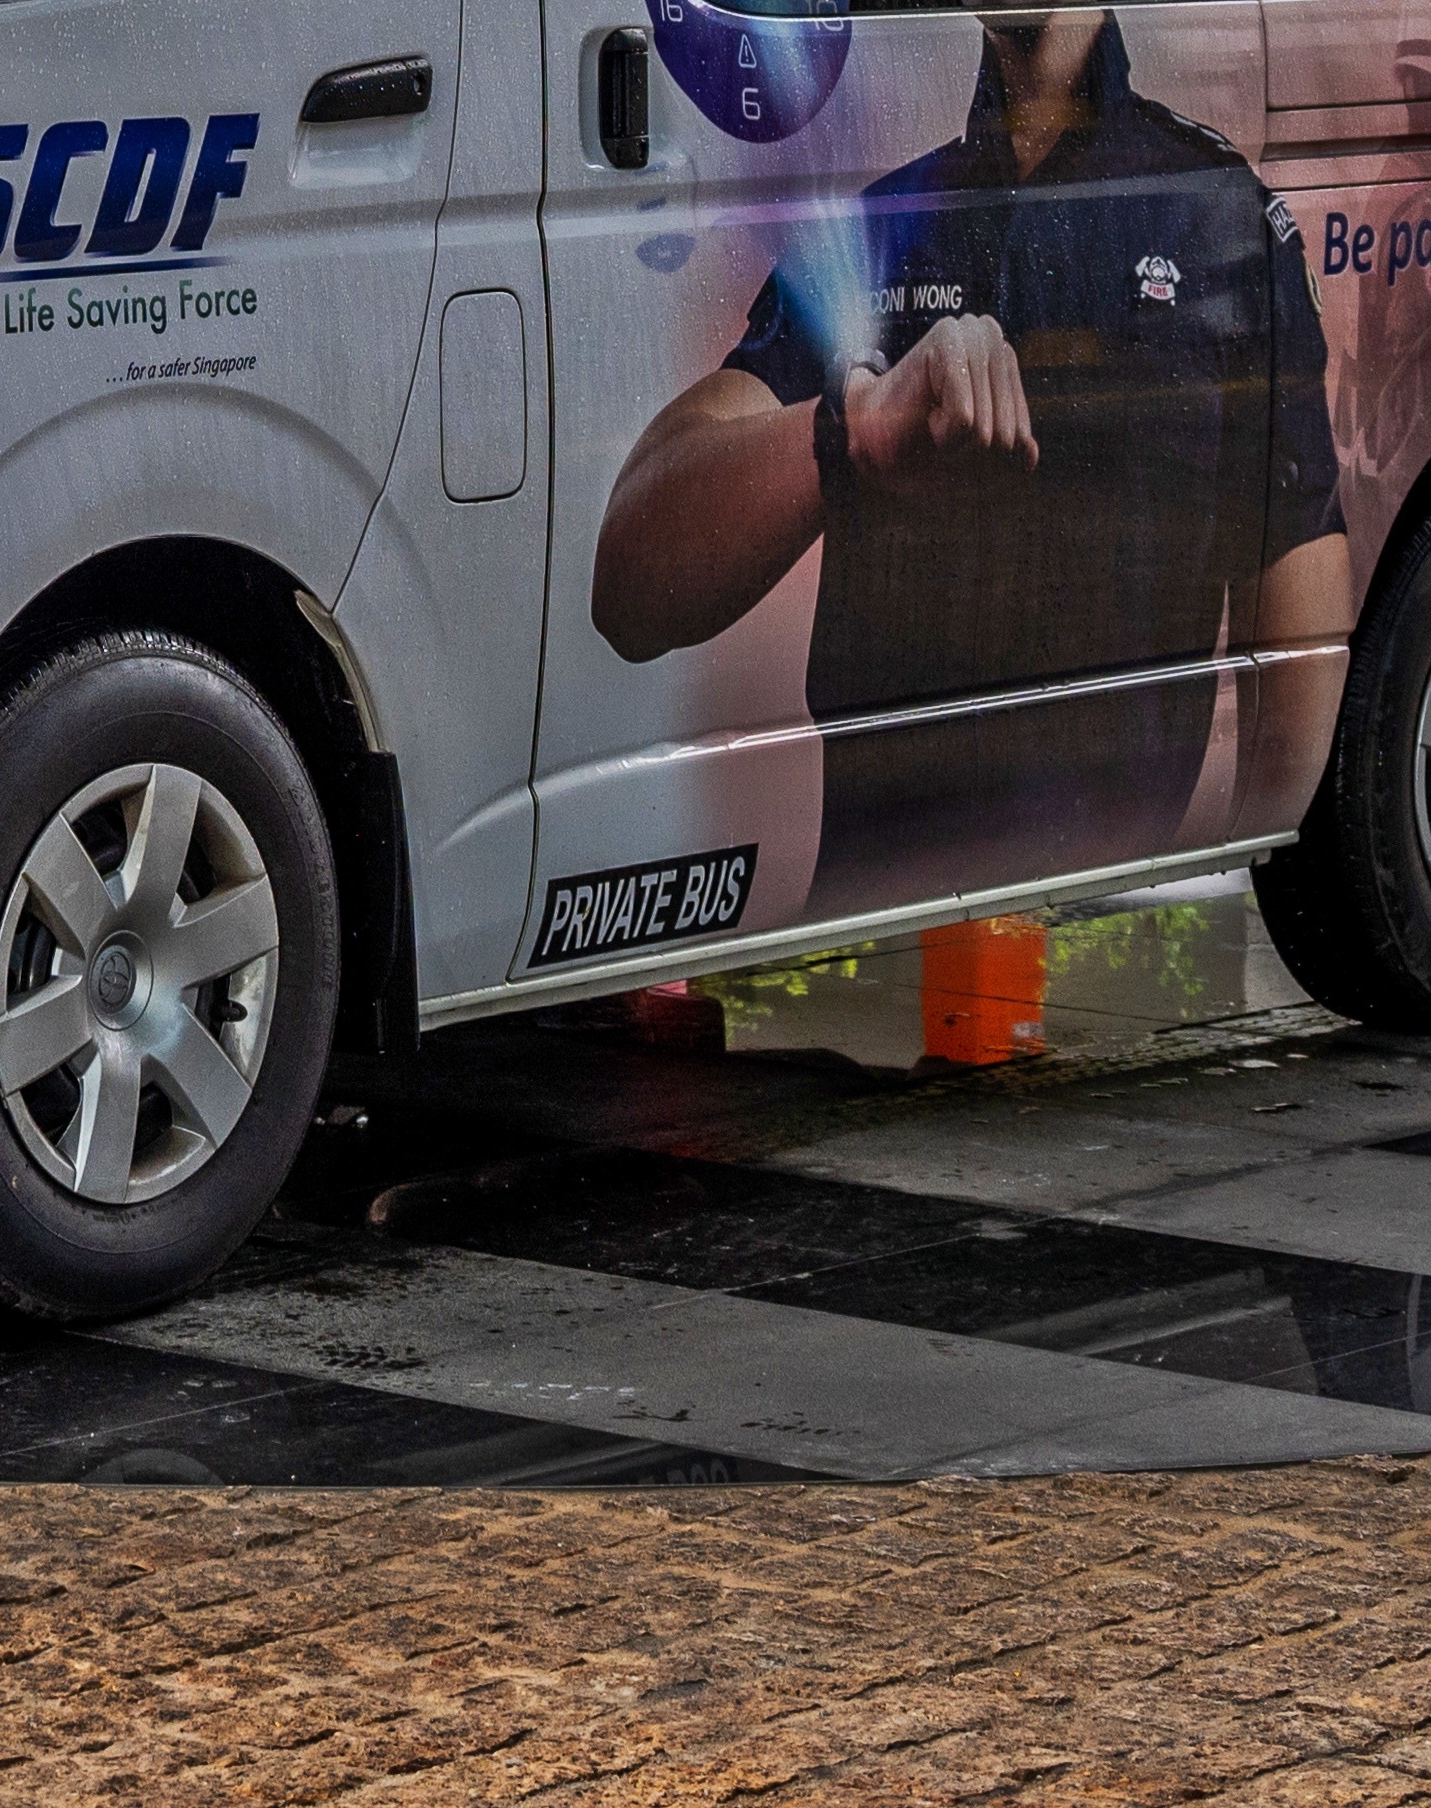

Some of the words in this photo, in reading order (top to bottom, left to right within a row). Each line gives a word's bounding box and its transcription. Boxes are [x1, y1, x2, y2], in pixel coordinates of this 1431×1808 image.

[742, 87, 761, 121] 6
[1324, 211, 1374, 276] Be
[3, 290, 56, 335] Life
[66, 284, 169, 336] Saving
[177, 279, 258, 319] Force
[912, 284, 963, 311] WONG
[1148, 284, 1168, 297] FIRE
[146, 364, 157, 377] a
[157, 356, 191, 377] safer
[192, 353, 257, 381] Singapore
[541, 868, 677, 957] PRIVATE
[675, 855, 746, 931] BUS
